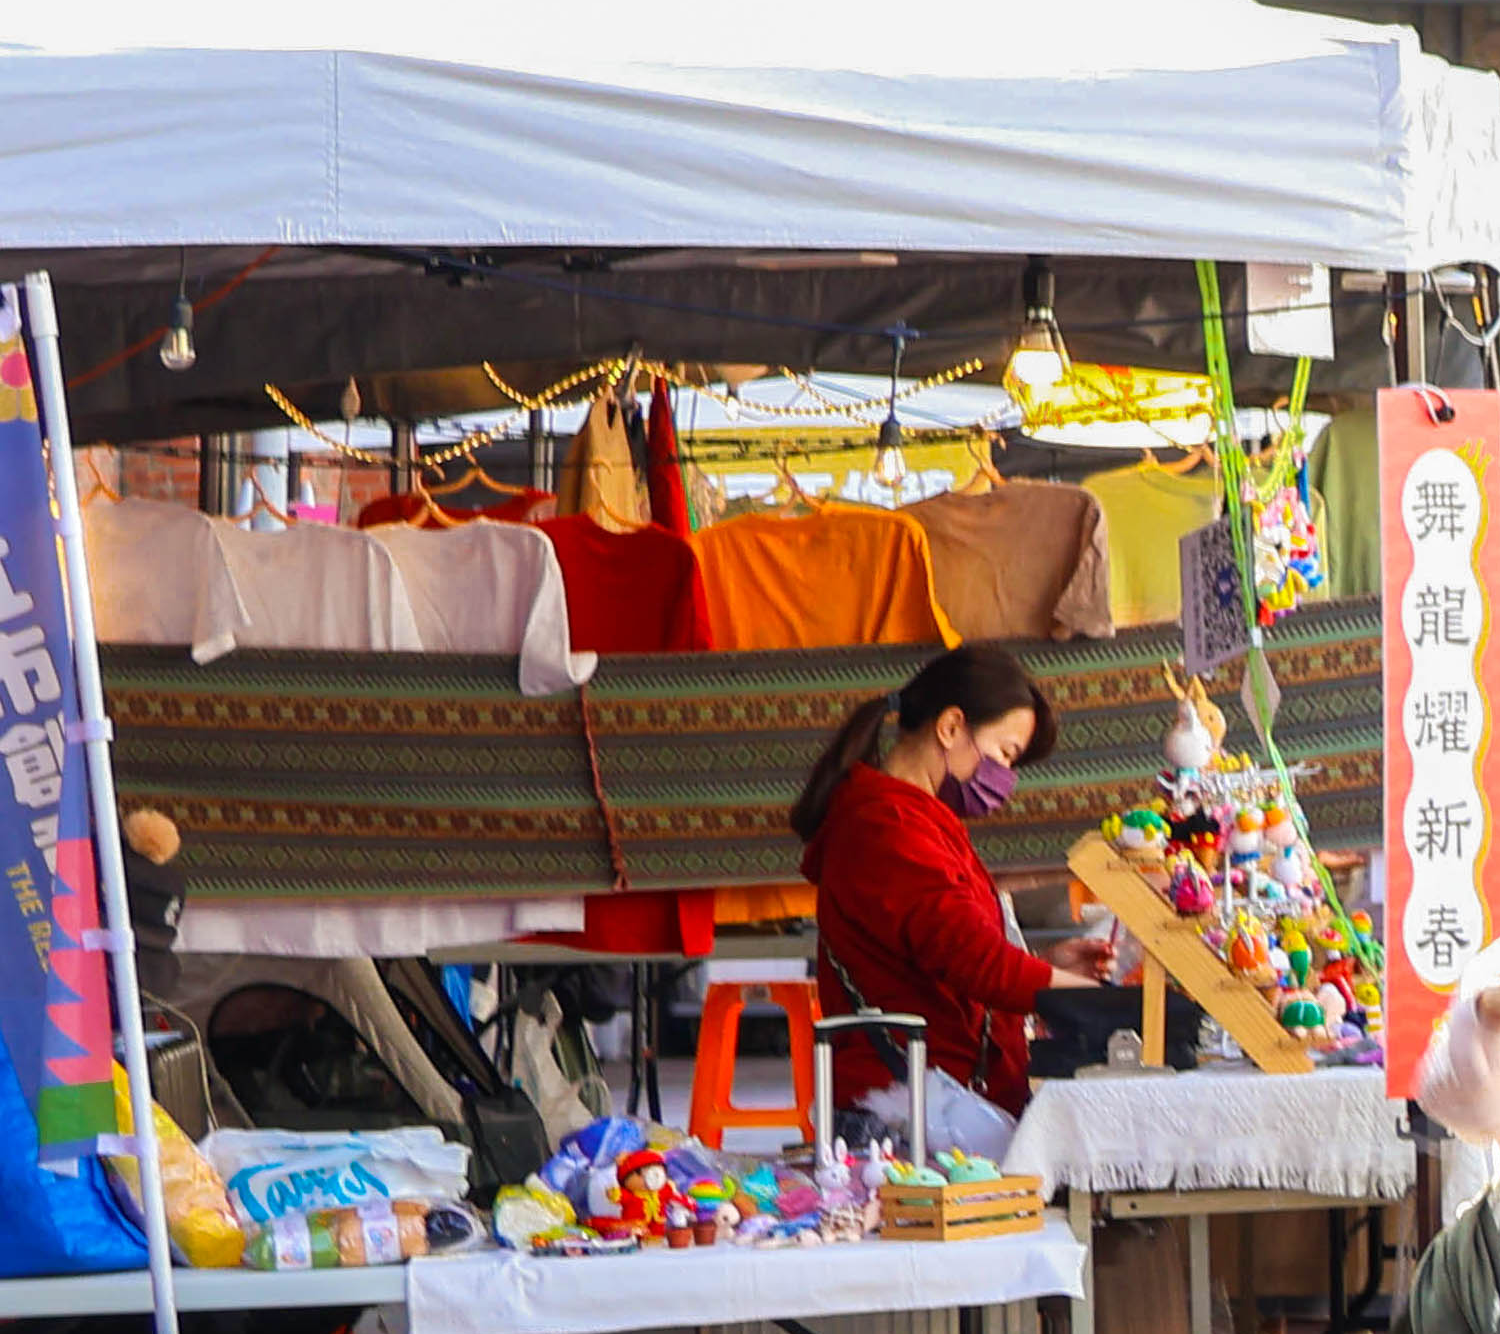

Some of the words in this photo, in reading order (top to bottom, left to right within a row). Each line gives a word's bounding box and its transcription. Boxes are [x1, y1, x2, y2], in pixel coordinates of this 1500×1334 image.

[1412, 480, 1472, 969] 舞龍耀新春
